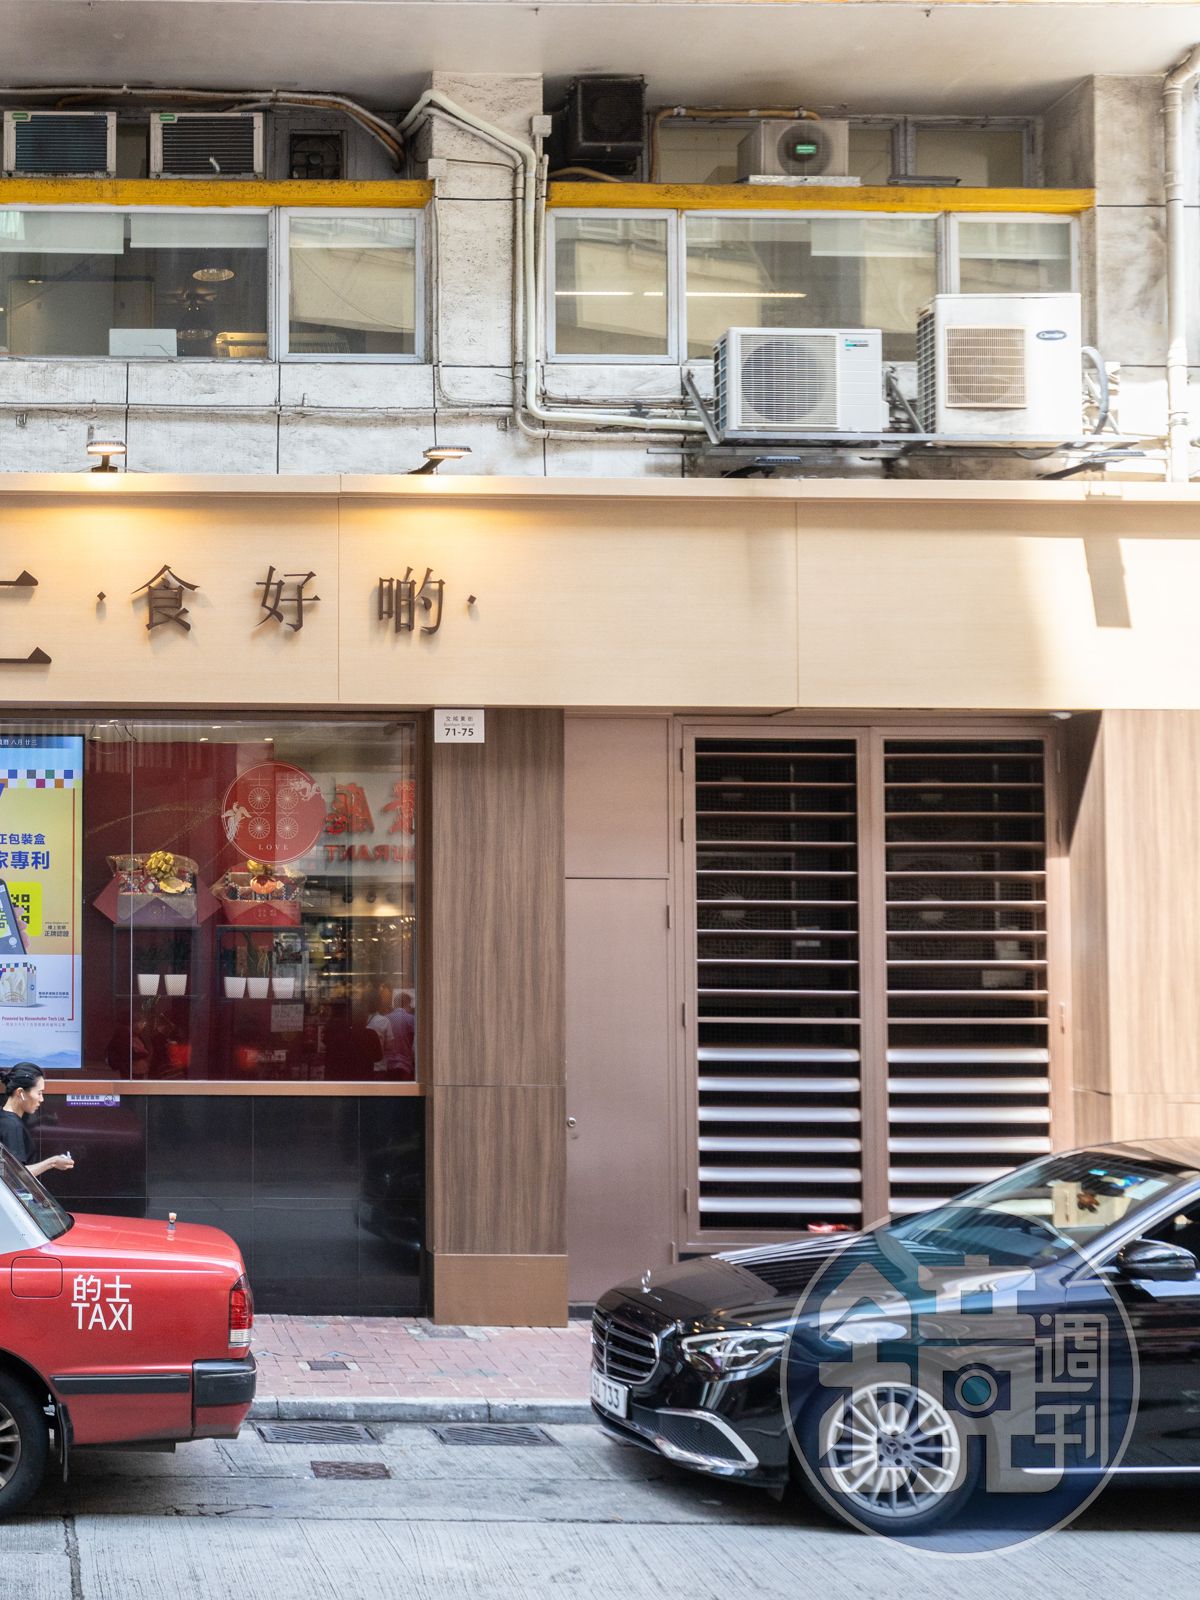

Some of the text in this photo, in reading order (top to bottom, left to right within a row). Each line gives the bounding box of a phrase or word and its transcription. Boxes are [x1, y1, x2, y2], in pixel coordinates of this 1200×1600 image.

[445, 728, 474, 736] 71-75
[72, 1274, 132, 1303] 的士
[70, 1302, 133, 1331] TAXI
